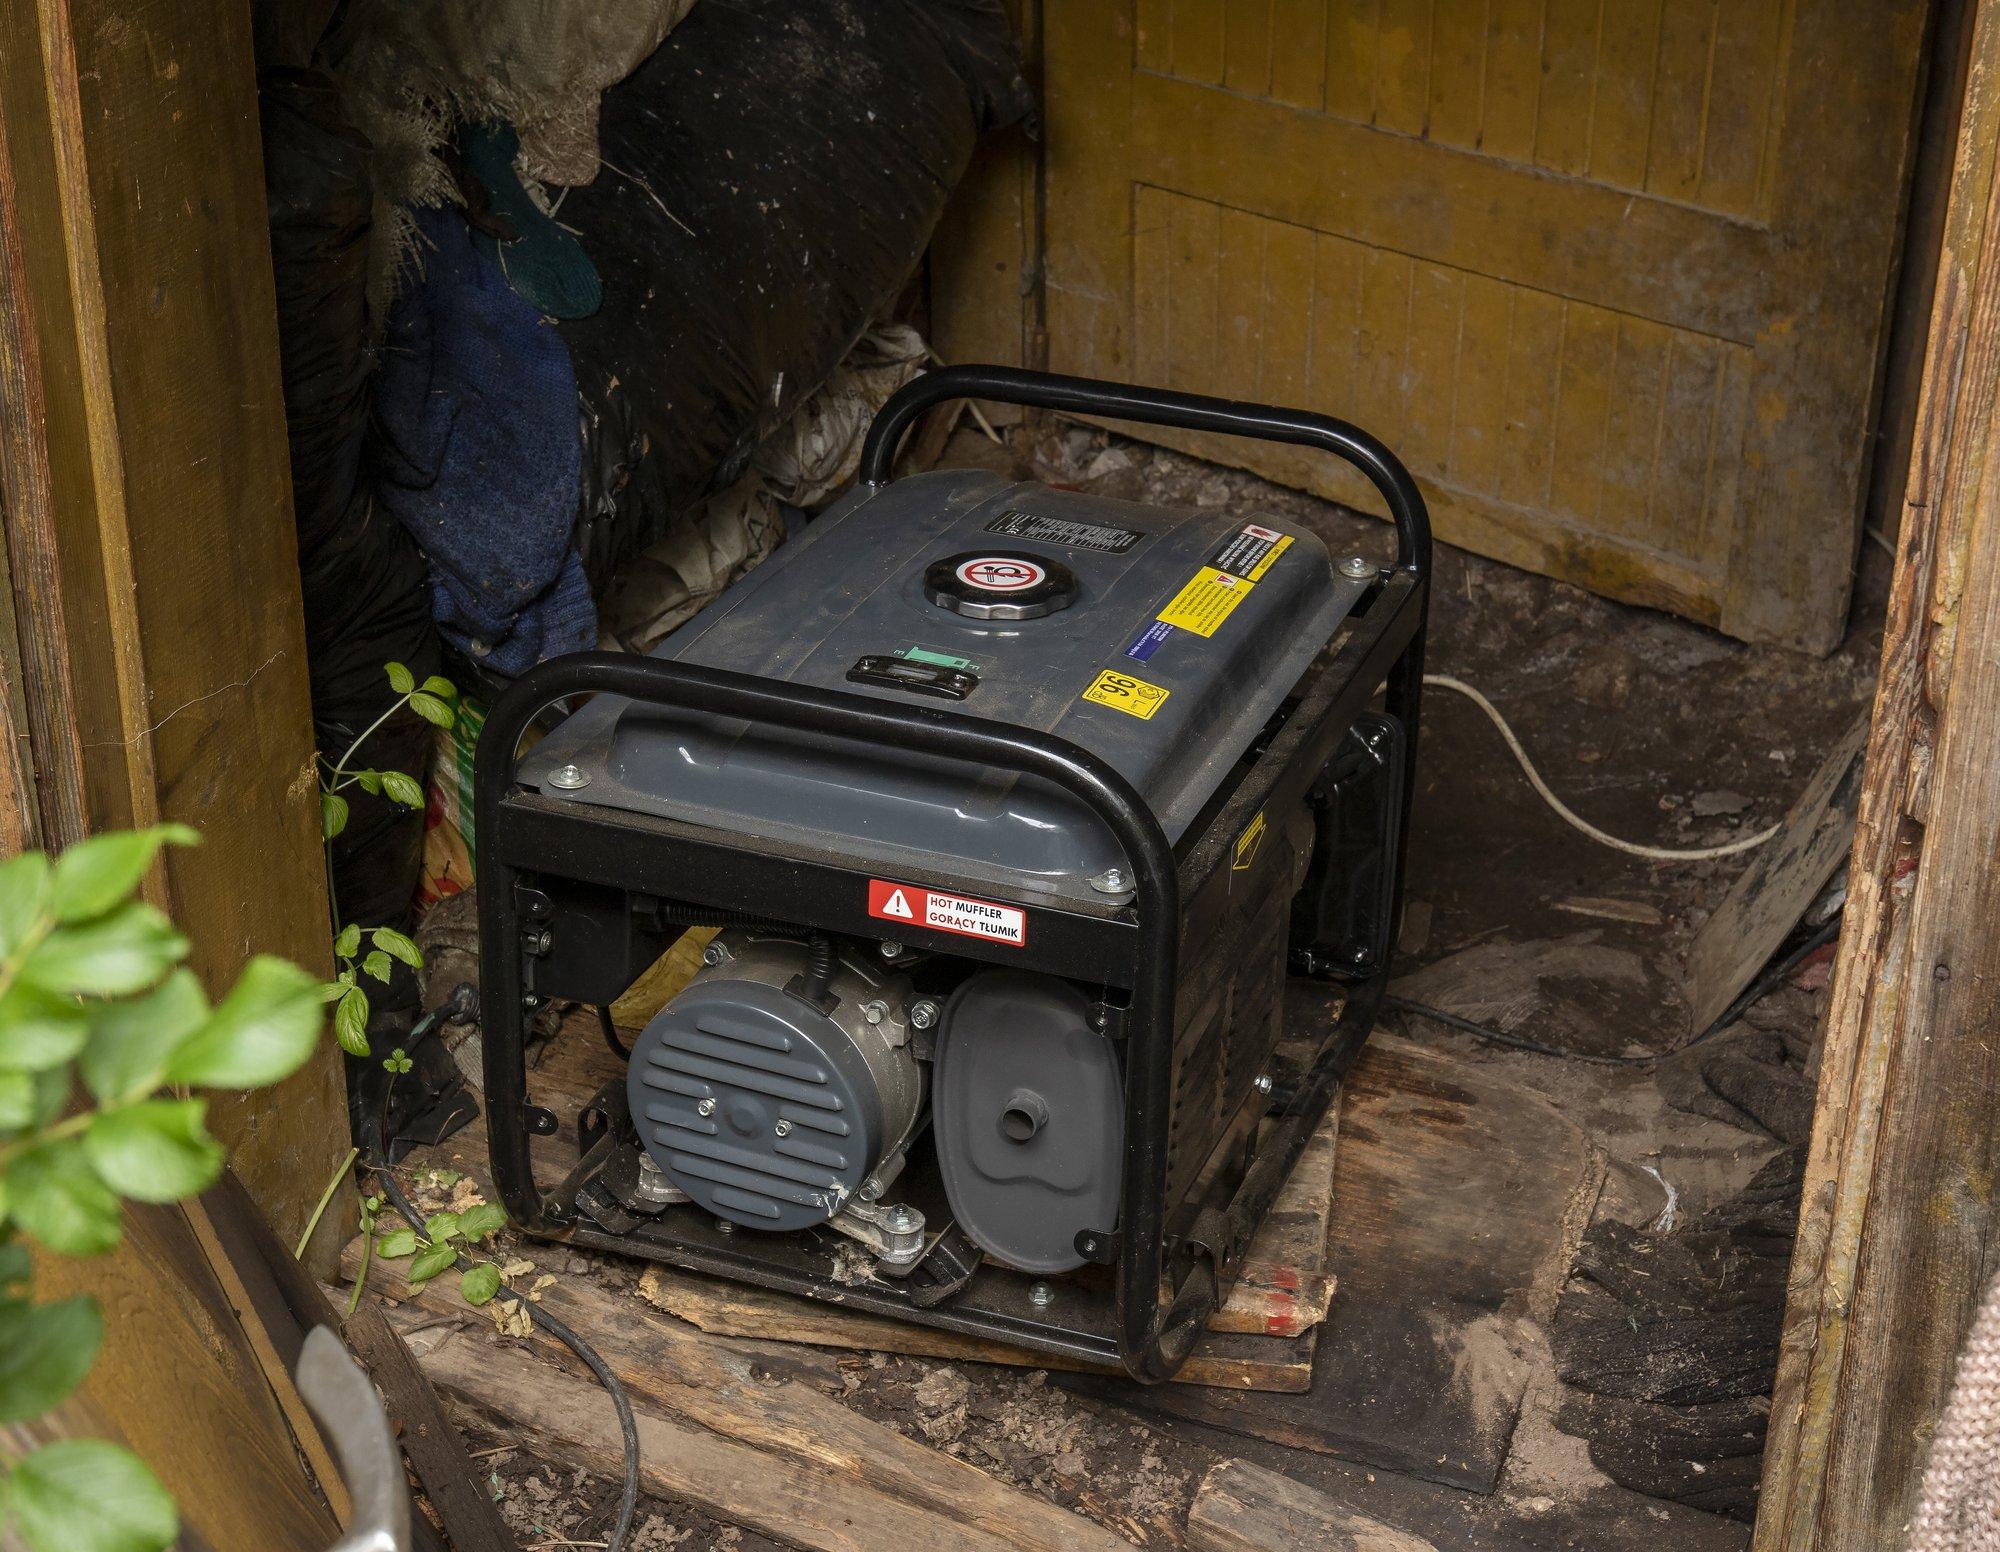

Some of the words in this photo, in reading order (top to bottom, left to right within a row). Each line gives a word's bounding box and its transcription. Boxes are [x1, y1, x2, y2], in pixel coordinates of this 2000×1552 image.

[1099, 676, 1136, 696] 96
[930, 897, 953, 909] HOT
[955, 902, 1002, 919] MUFFLER
[930, 912, 976, 929] GORĄCY
[979, 922, 1018, 938] TŁUMIK
